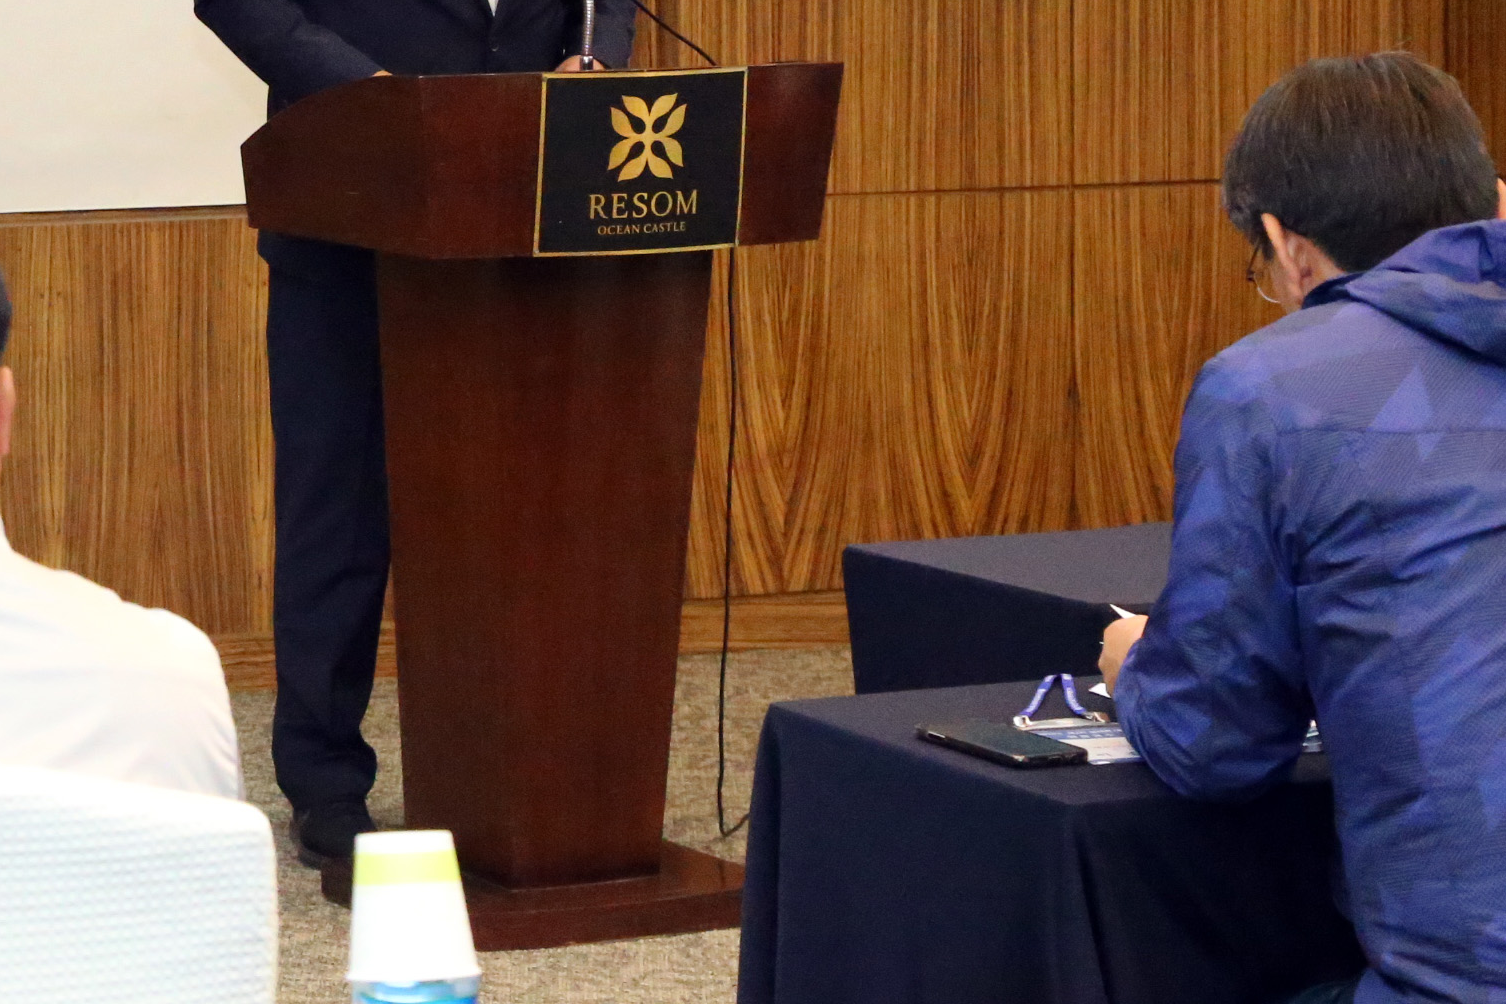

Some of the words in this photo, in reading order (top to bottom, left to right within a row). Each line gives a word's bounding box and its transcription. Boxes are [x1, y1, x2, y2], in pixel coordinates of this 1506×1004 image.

[588, 188, 698, 221] RESOM
[597, 224, 641, 236] OCEAN
[643, 221, 687, 234] CASTLE
